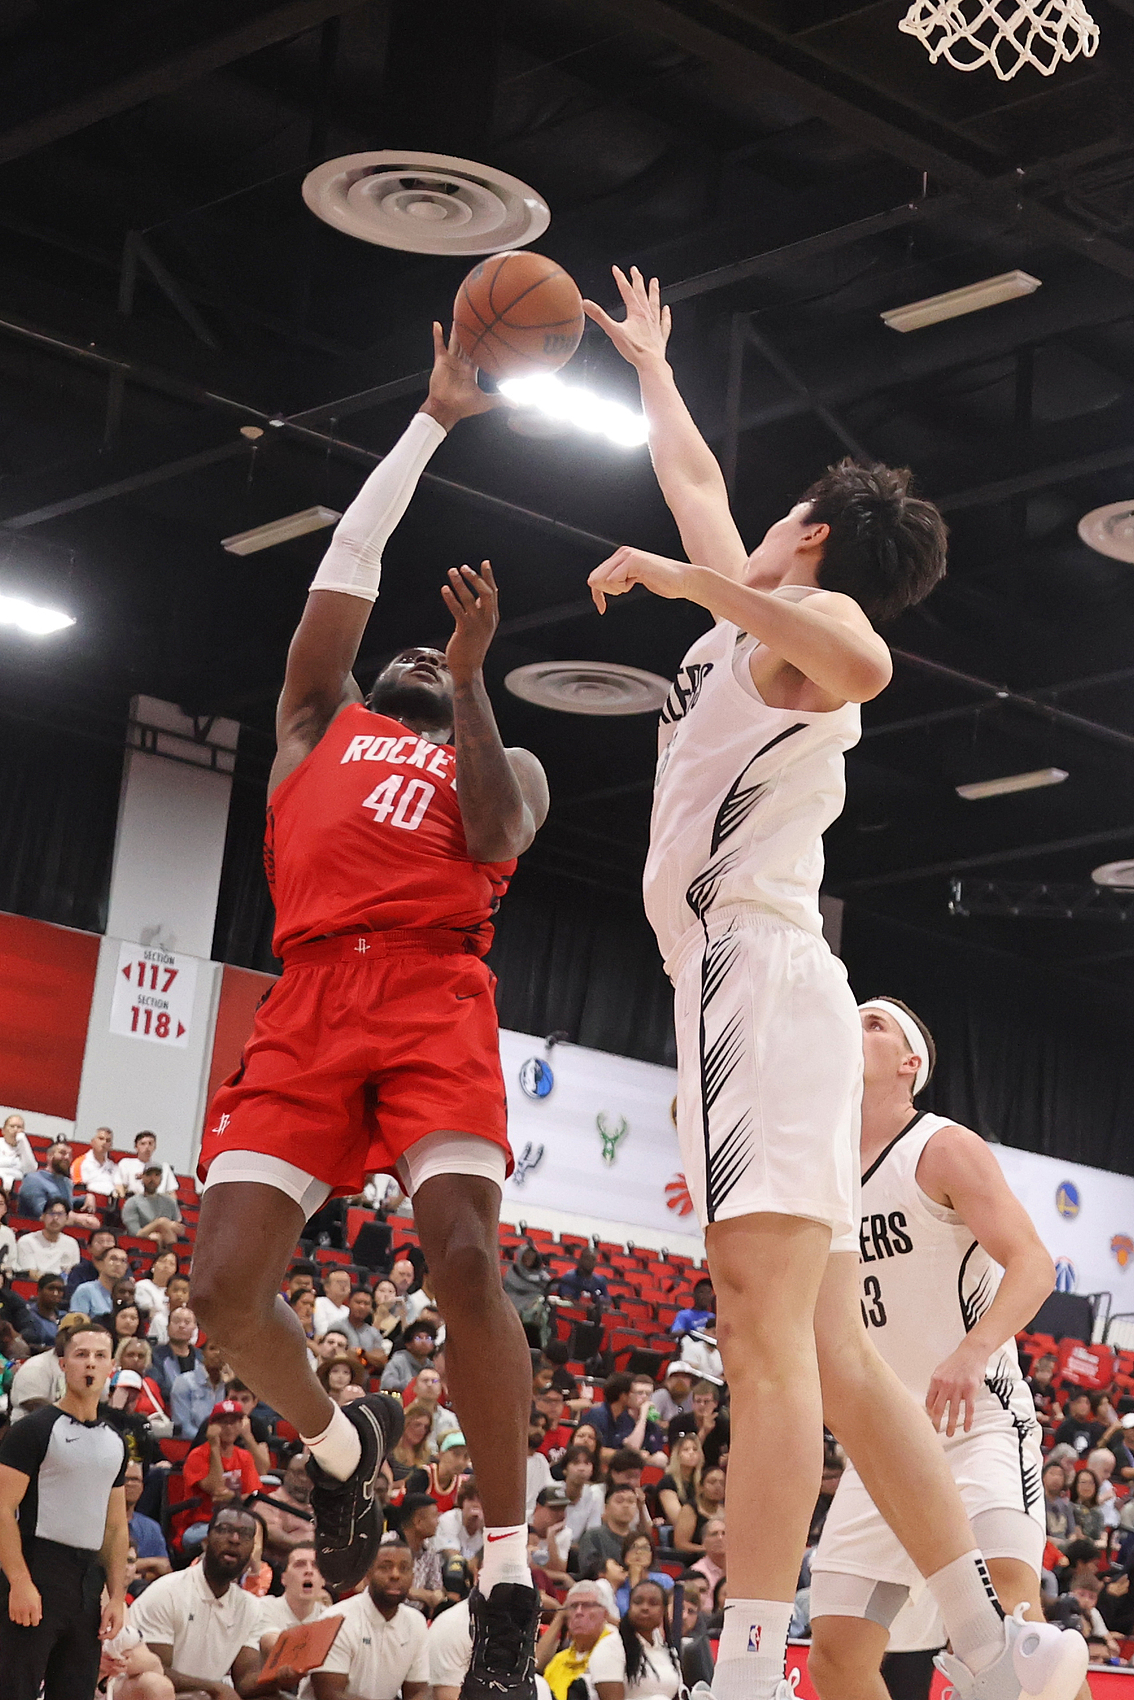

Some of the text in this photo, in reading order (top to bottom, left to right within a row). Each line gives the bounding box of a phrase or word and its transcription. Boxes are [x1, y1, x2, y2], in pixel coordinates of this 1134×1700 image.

[340, 735, 456, 788] ROCKE
[362, 774, 435, 831] 40
[143, 951, 175, 965] SECTION
[138, 960, 179, 993] 117
[137, 994, 169, 1010] SECTION
[131, 1005, 171, 1039] 118
[859, 1211, 914, 1264] ERS
